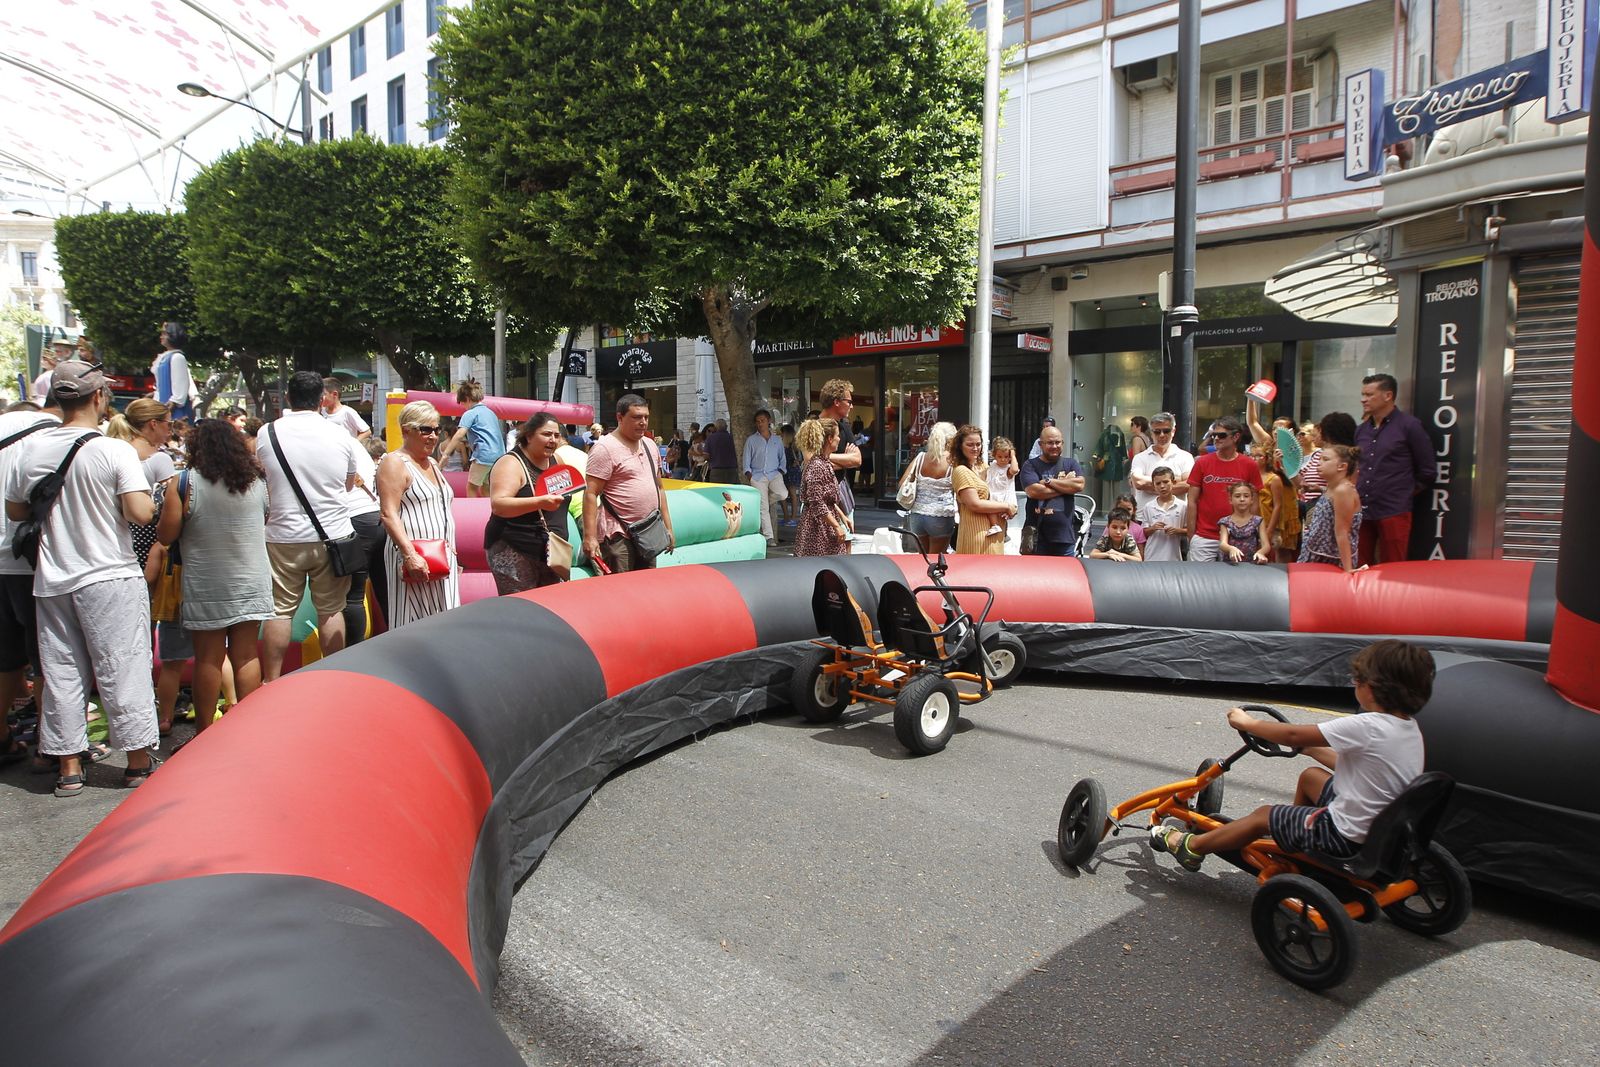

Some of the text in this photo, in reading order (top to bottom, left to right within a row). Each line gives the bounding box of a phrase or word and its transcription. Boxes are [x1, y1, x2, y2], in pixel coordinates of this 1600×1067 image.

[1557, 0, 1575, 115] ELOJERIA
[1352, 80, 1365, 170] JOYERIA
[1392, 70, 1531, 135] Troyano
[1424, 285, 1479, 303] TROYANO
[1195, 328, 1235, 336] RIFICACION
